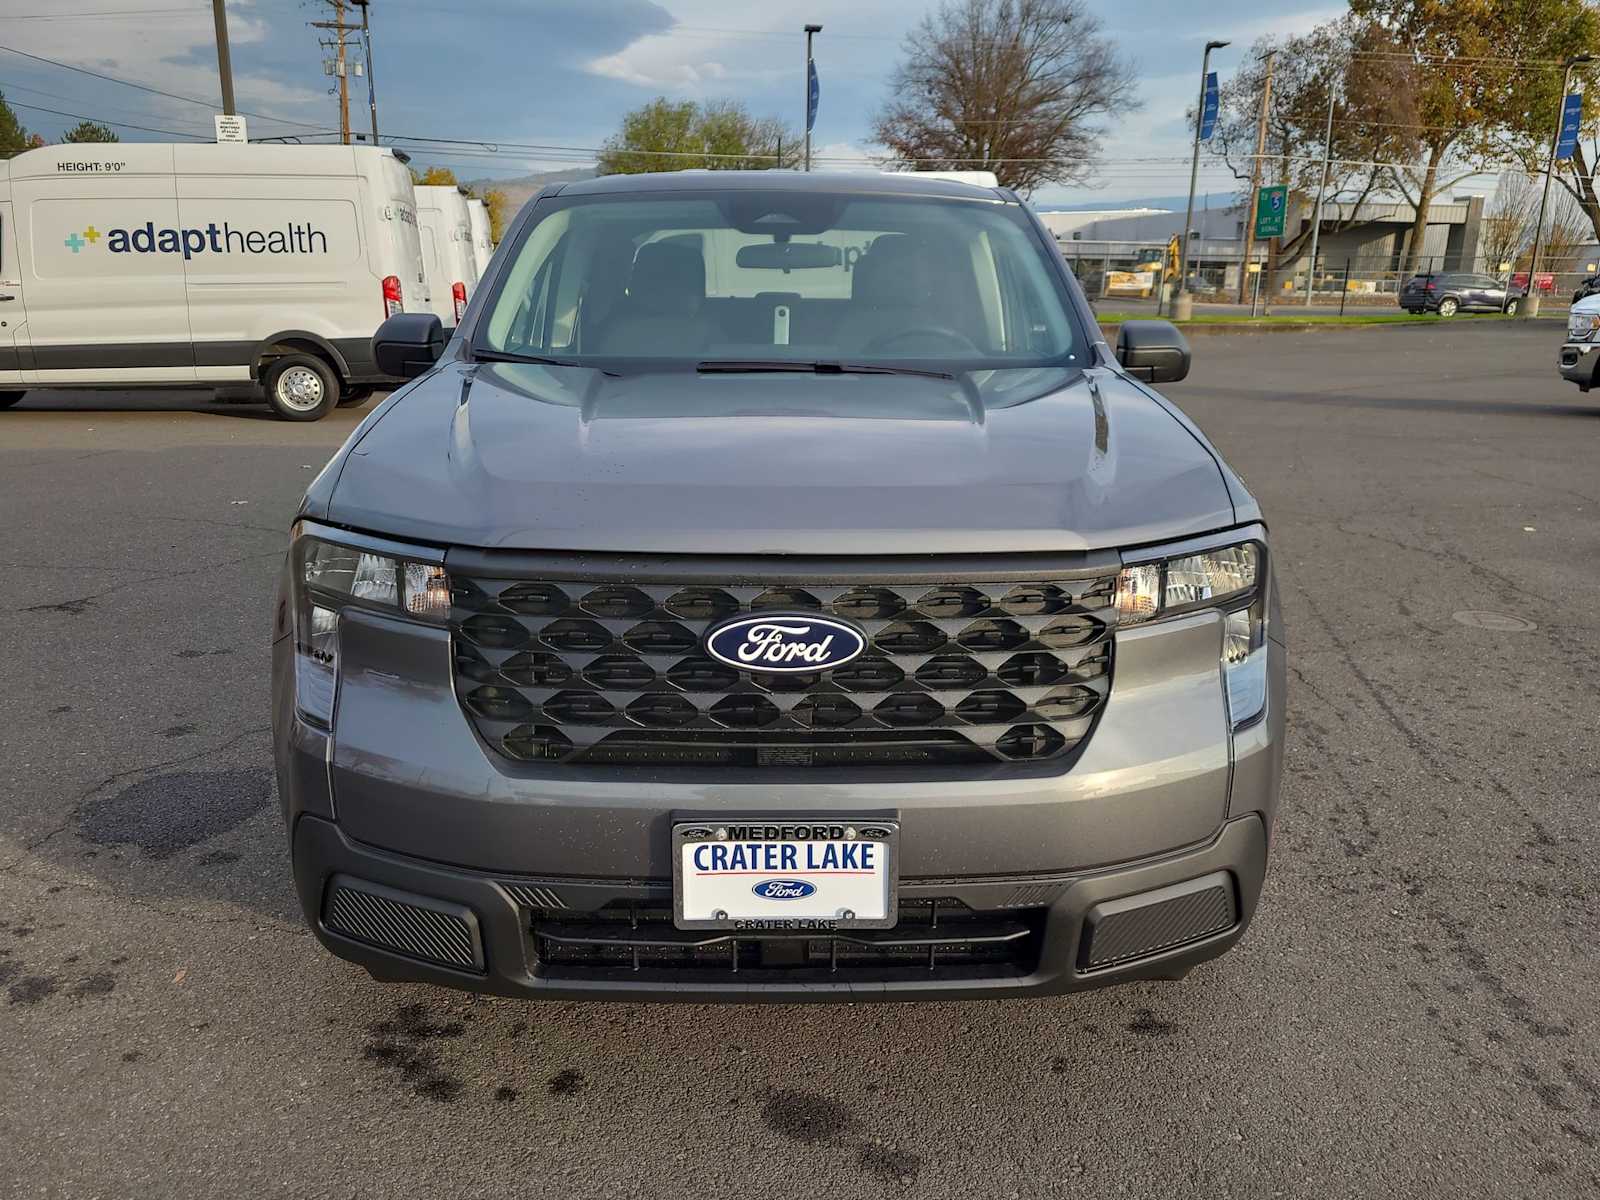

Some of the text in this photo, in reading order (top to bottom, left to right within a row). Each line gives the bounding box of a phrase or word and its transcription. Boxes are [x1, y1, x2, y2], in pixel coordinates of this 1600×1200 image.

[57, 162, 102, 172] HEIGHT:
[107, 221, 328, 260] adapthealth
[737, 624, 835, 662] Ford
[728, 825, 845, 841] MEDFORD
[693, 843, 875, 871] CRATER LAKE
[764, 881, 804, 898] Ford
[734, 919, 838, 929] CRATER LAKE
